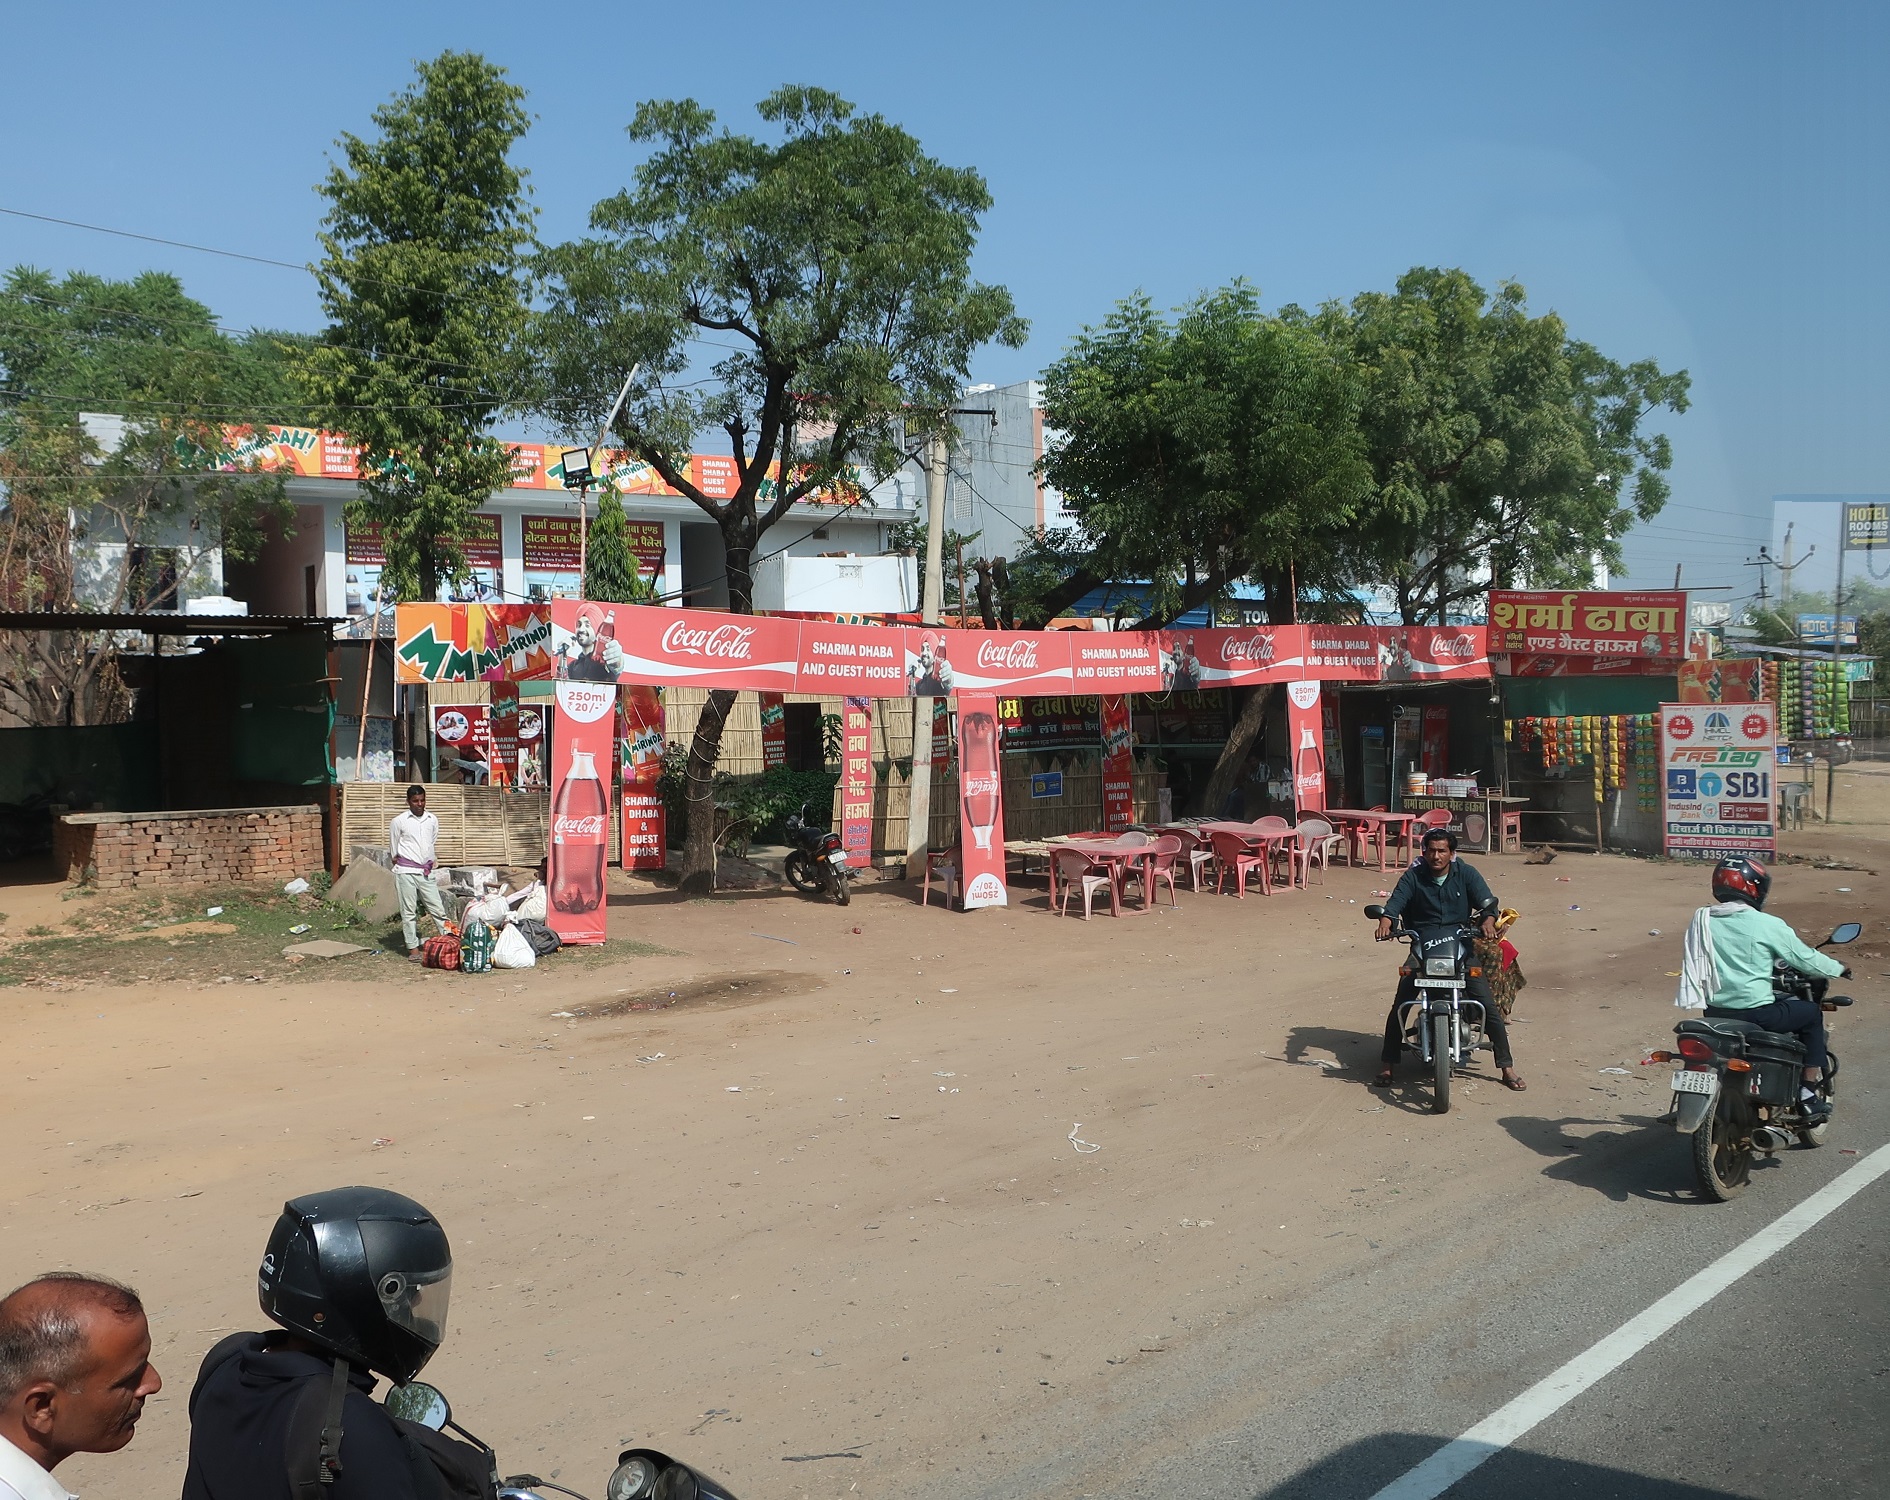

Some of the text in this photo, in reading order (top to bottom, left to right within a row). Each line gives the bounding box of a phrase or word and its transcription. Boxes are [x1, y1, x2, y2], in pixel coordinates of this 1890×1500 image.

[325, 464, 353, 473] HOUSE
[702, 460, 731, 469] SHARMA
[702, 469, 726, 477] DHABA
[702, 478, 726, 486] GUEST
[703, 487, 727, 495] HOUSE
[1849, 507, 1889, 521] HOTEL
[1849, 521, 1889, 531] ROOMS
[1493, 594, 1680, 633] शर्मा ढाबा
[661, 620, 757, 659] Coca-Cola
[1311, 640, 1370, 650] SHARMA DHABA
[1430, 633, 1477, 657] Coca-Cola
[1527, 636, 1557, 652] एण्ड
[1593, 638, 1639, 654] हाऊस
[812, 641, 894, 658] SHARMA DHABA
[977, 638, 1040, 669] Coca-Cola
[1081, 647, 1150, 660] SHARMA DHABA
[1221, 634, 1275, 662] Coca-Cola
[1306, 656, 1376, 667] AND GUEST HOUSE
[802, 662, 901, 679] AND GUEST HOUSE
[1076, 665, 1157, 678] AND GUEST HOUSE
[1295, 686, 1316, 694] 250ml
[568, 691, 606, 701] 250ml
[1675, 718, 1686, 726] 24
[1039, 722, 1058, 734] लंच
[632, 732, 664, 753] MIRINDA
[848, 735, 867, 751] ढाबा
[848, 758, 867, 774] एण्ड
[1297, 772, 1322, 788] Coca-Cola
[1725, 772, 1769, 798] SBI
[966, 780, 998, 796] Coca-Cola
[1105, 782, 1130, 790] SHARMA
[1108, 793, 1128, 801] DHABA
[845, 803, 870, 820] हाऊस
[1116, 803, 1121, 811] &
[629, 809, 659, 818] DHABA
[1110, 813, 1128, 821] GUEST
[1681, 811, 1701, 819] Bank
[554, 815, 606, 834] Coca-Cola
[640, 821, 648, 831] &
[1110, 824, 1126, 832] HOUS
[630, 834, 659, 844] GUEST
[629, 847, 659, 857] HOUSE
[1670, 848, 1699, 859] Mob.:
[972, 890, 999, 900] 250ml
[1424, 936, 1455, 950] Kiran
[1683, 1072, 1712, 1084] RJ29S
[1681, 1081, 1711, 1093] R4693
